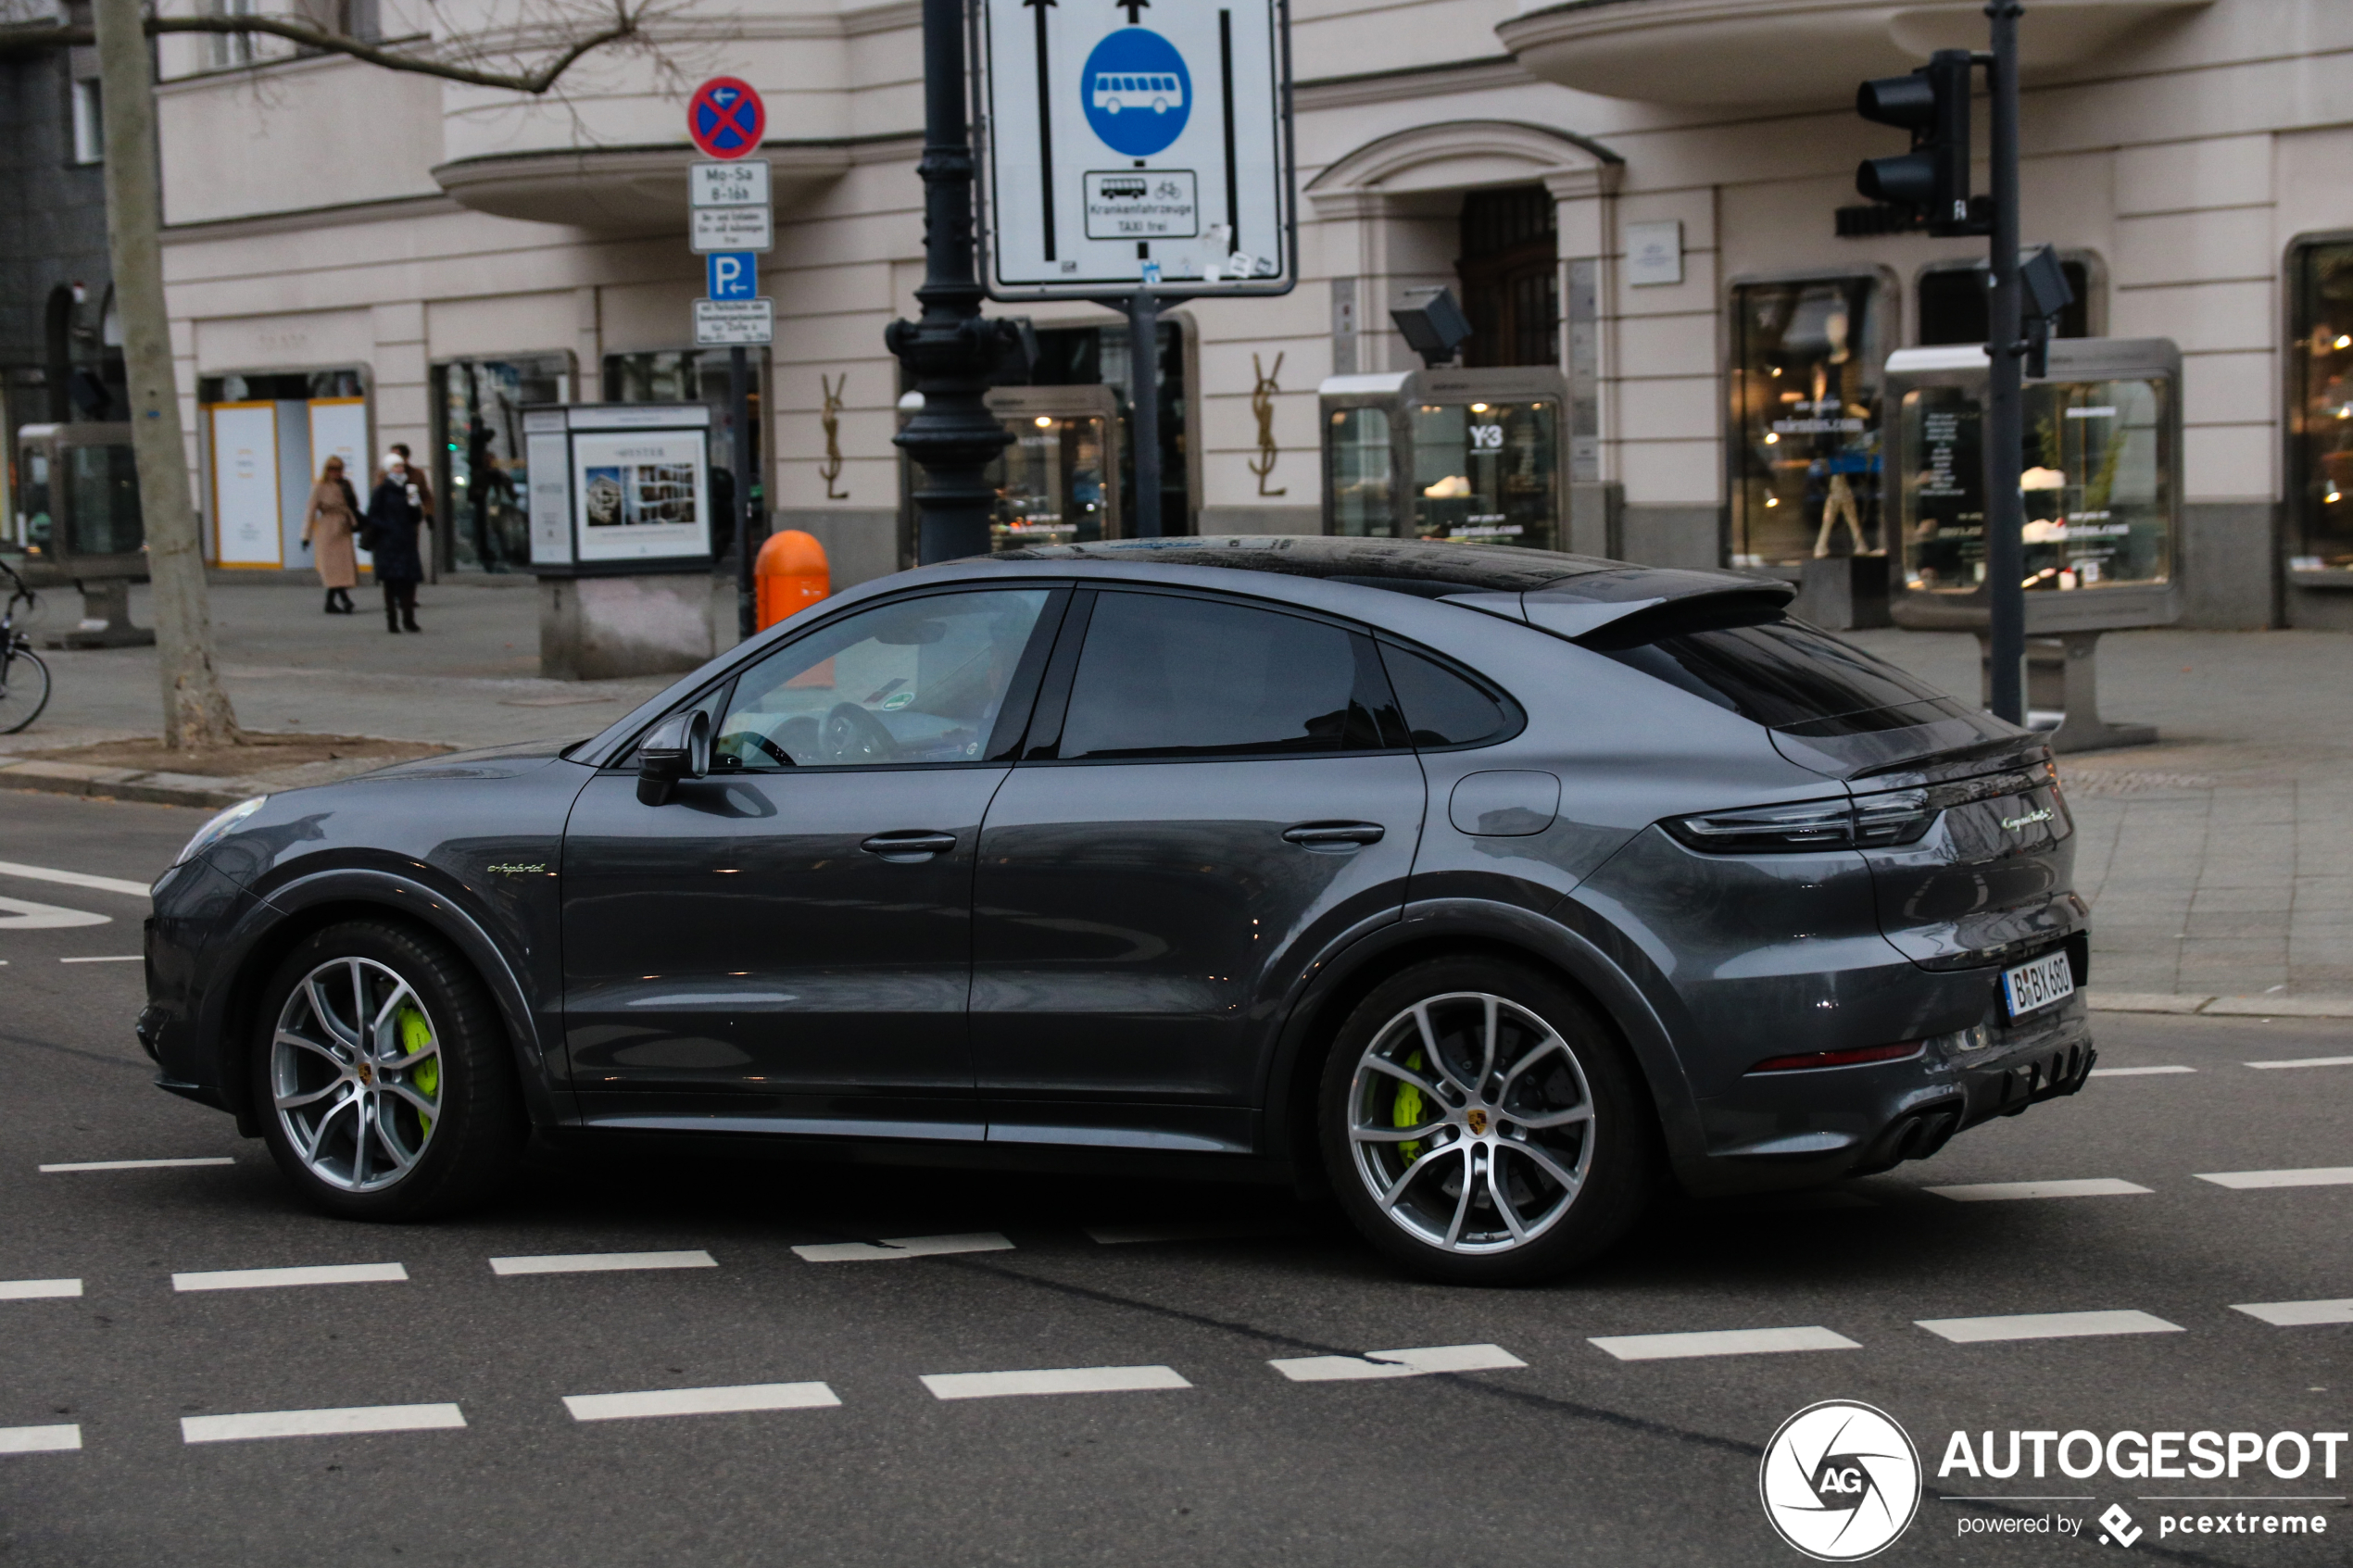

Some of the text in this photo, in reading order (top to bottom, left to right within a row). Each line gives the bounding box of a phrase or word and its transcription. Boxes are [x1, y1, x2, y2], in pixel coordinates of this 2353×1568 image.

[706, 167, 753, 181] Mo-Sa
[1090, 204, 1191, 216] Krankenfahrzeuge
[1118, 220, 1166, 232] TAXI frei
[715, 257, 742, 295] P
[487, 862, 547, 878] e-hybrid
[2014, 972, 2027, 1008] B
[2048, 957, 2070, 996] 680
